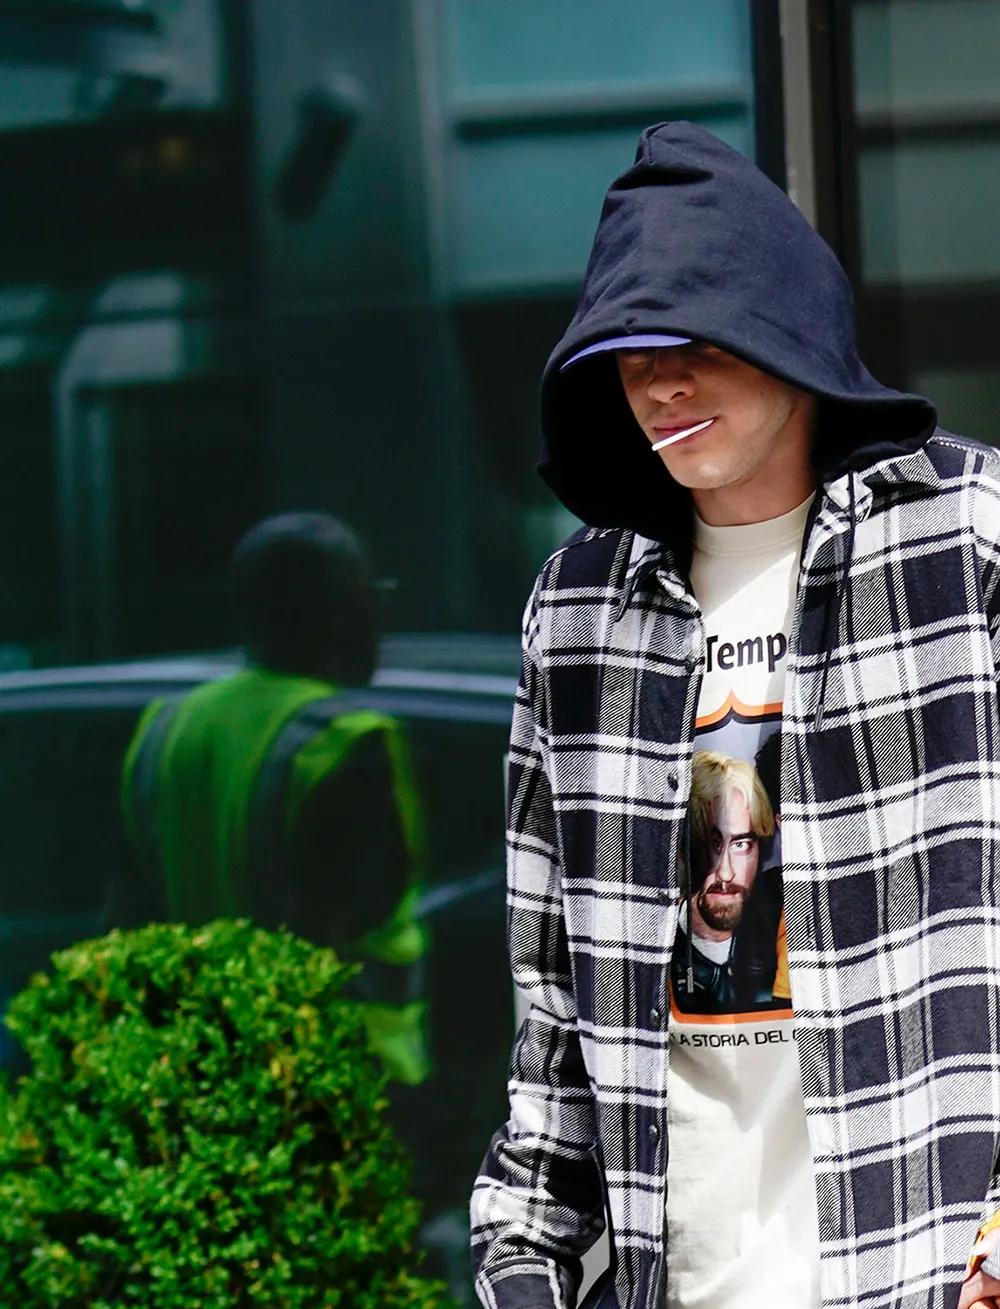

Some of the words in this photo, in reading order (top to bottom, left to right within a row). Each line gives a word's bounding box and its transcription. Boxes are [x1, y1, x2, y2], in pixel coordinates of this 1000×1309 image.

[706, 632, 790, 673] Temp
[692, 1033, 750, 1048] STORIA
[754, 1030, 789, 1045] DEL
